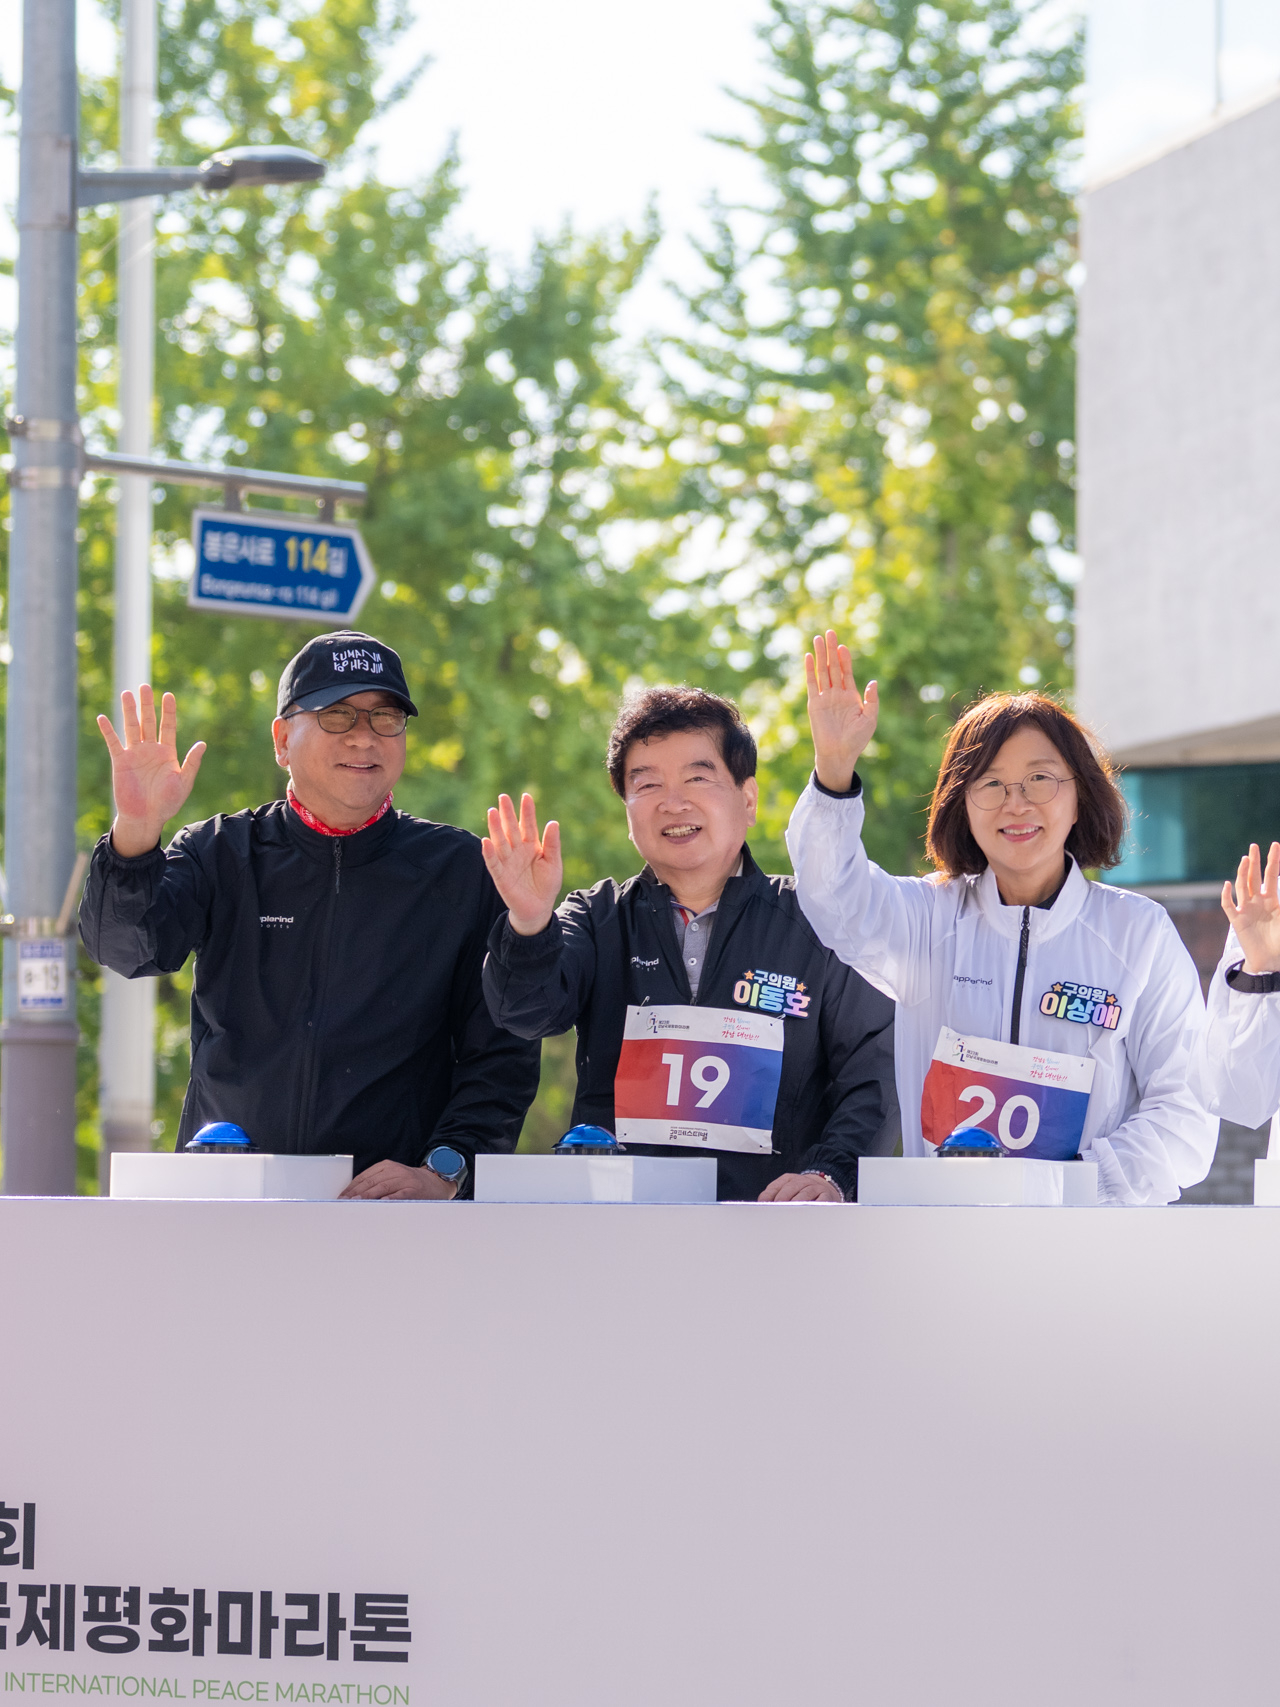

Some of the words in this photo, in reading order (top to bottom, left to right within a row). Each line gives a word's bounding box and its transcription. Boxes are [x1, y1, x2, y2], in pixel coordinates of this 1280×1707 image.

[733, 980, 812, 1018] 이동호
[753, 969, 797, 991] 구의원
[1062, 982, 1107, 1003] 구의원
[1040, 992, 1121, 1030] 이상애
[661, 1052, 731, 1109] 19
[954, 1084, 1041, 1151] 20
[4, 1671, 187, 1700] INTERNATIONAL
[192, 1678, 269, 1702] PEACE
[275, 1682, 410, 1706] MARATHON
